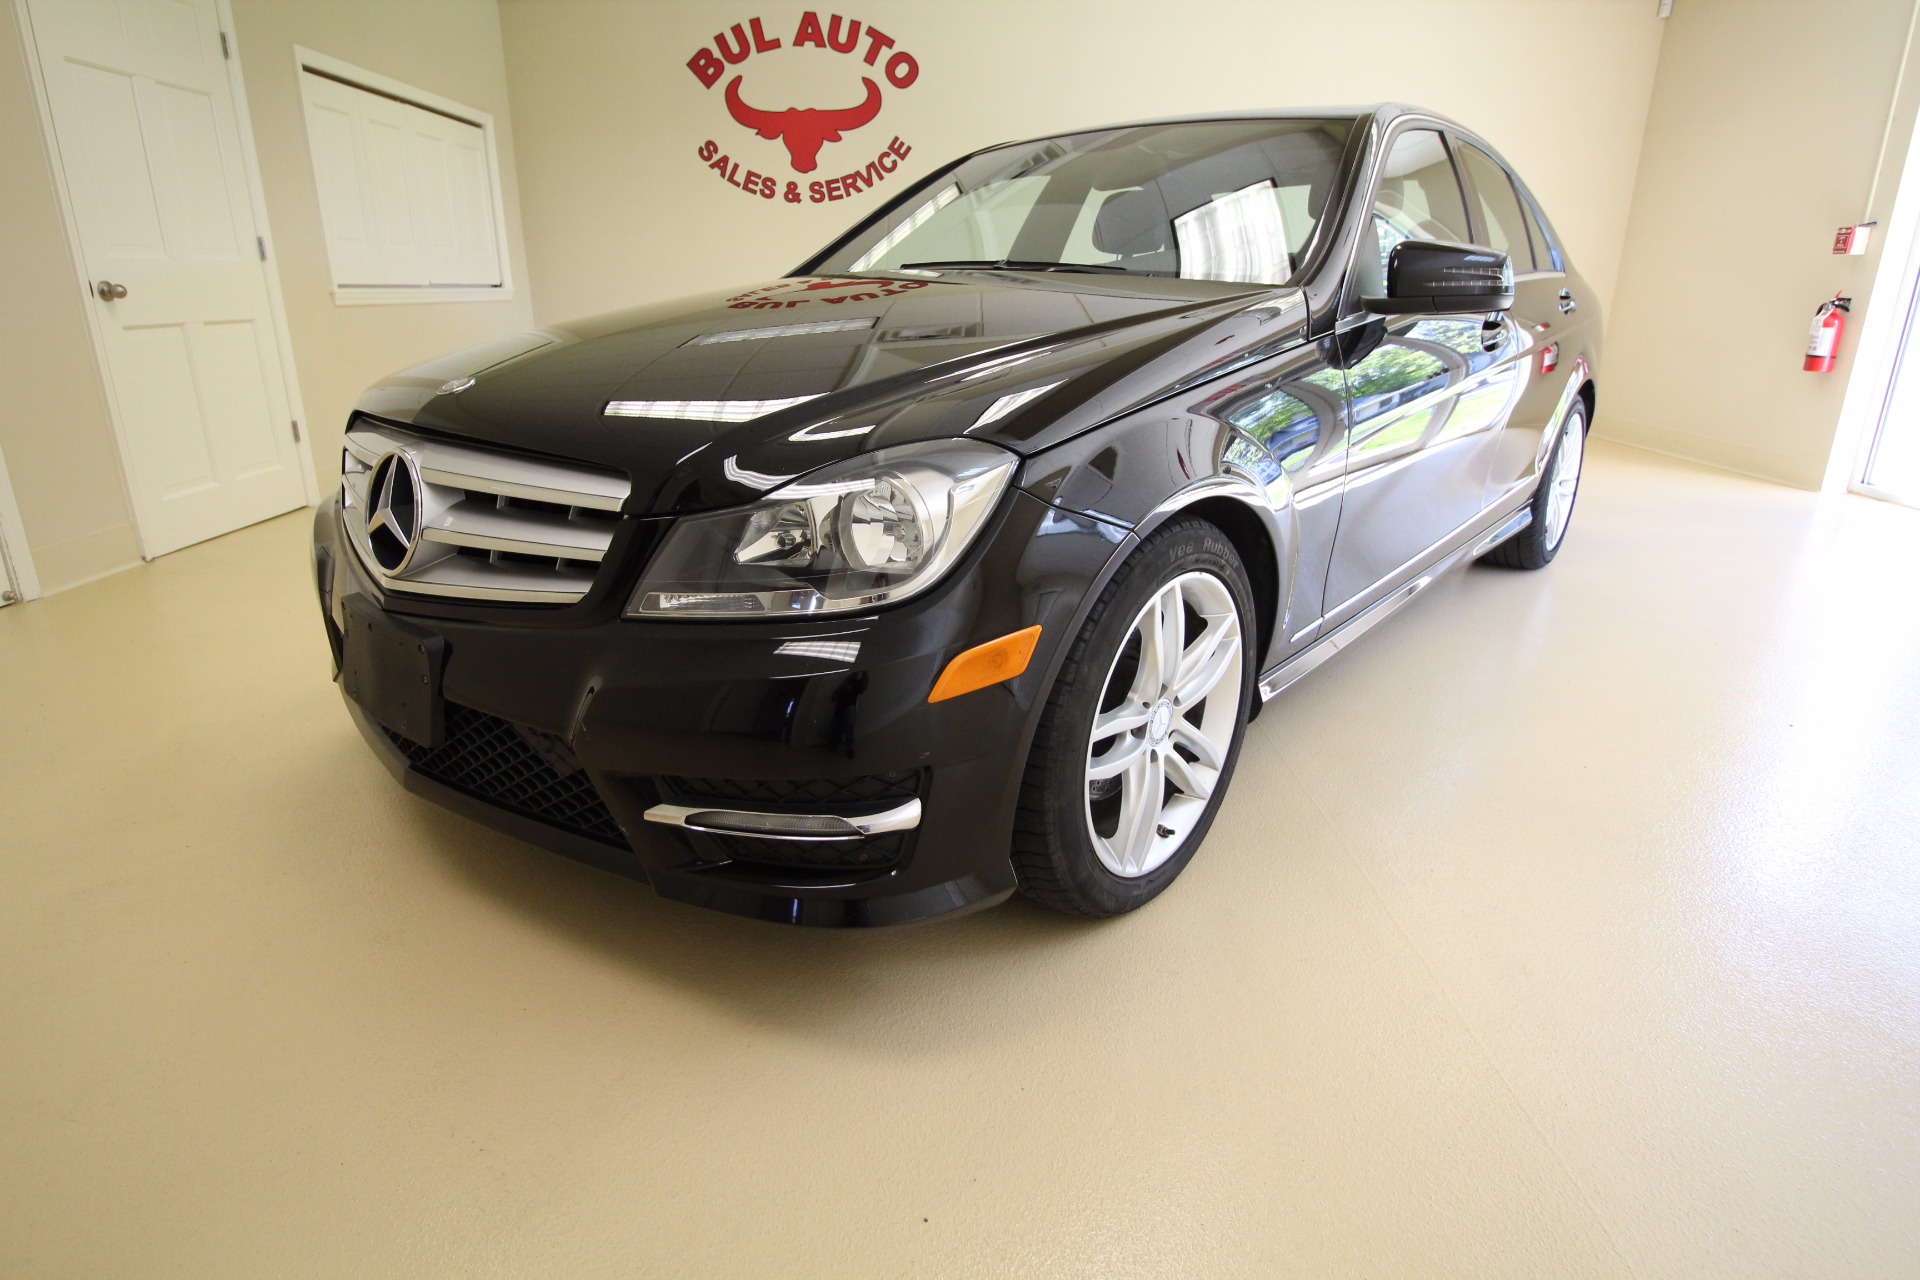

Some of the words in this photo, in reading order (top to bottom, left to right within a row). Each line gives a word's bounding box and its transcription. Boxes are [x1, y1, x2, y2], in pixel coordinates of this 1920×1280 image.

[686, 17, 782, 90] BUL
[792, 11, 919, 89] AUTO
[698, 140, 776, 199] SALES
[784, 181, 801, 203] &
[809, 136, 912, 203] SERVICE
[1169, 541, 1194, 563] Vee
[1202, 537, 1239, 569] Rubber
